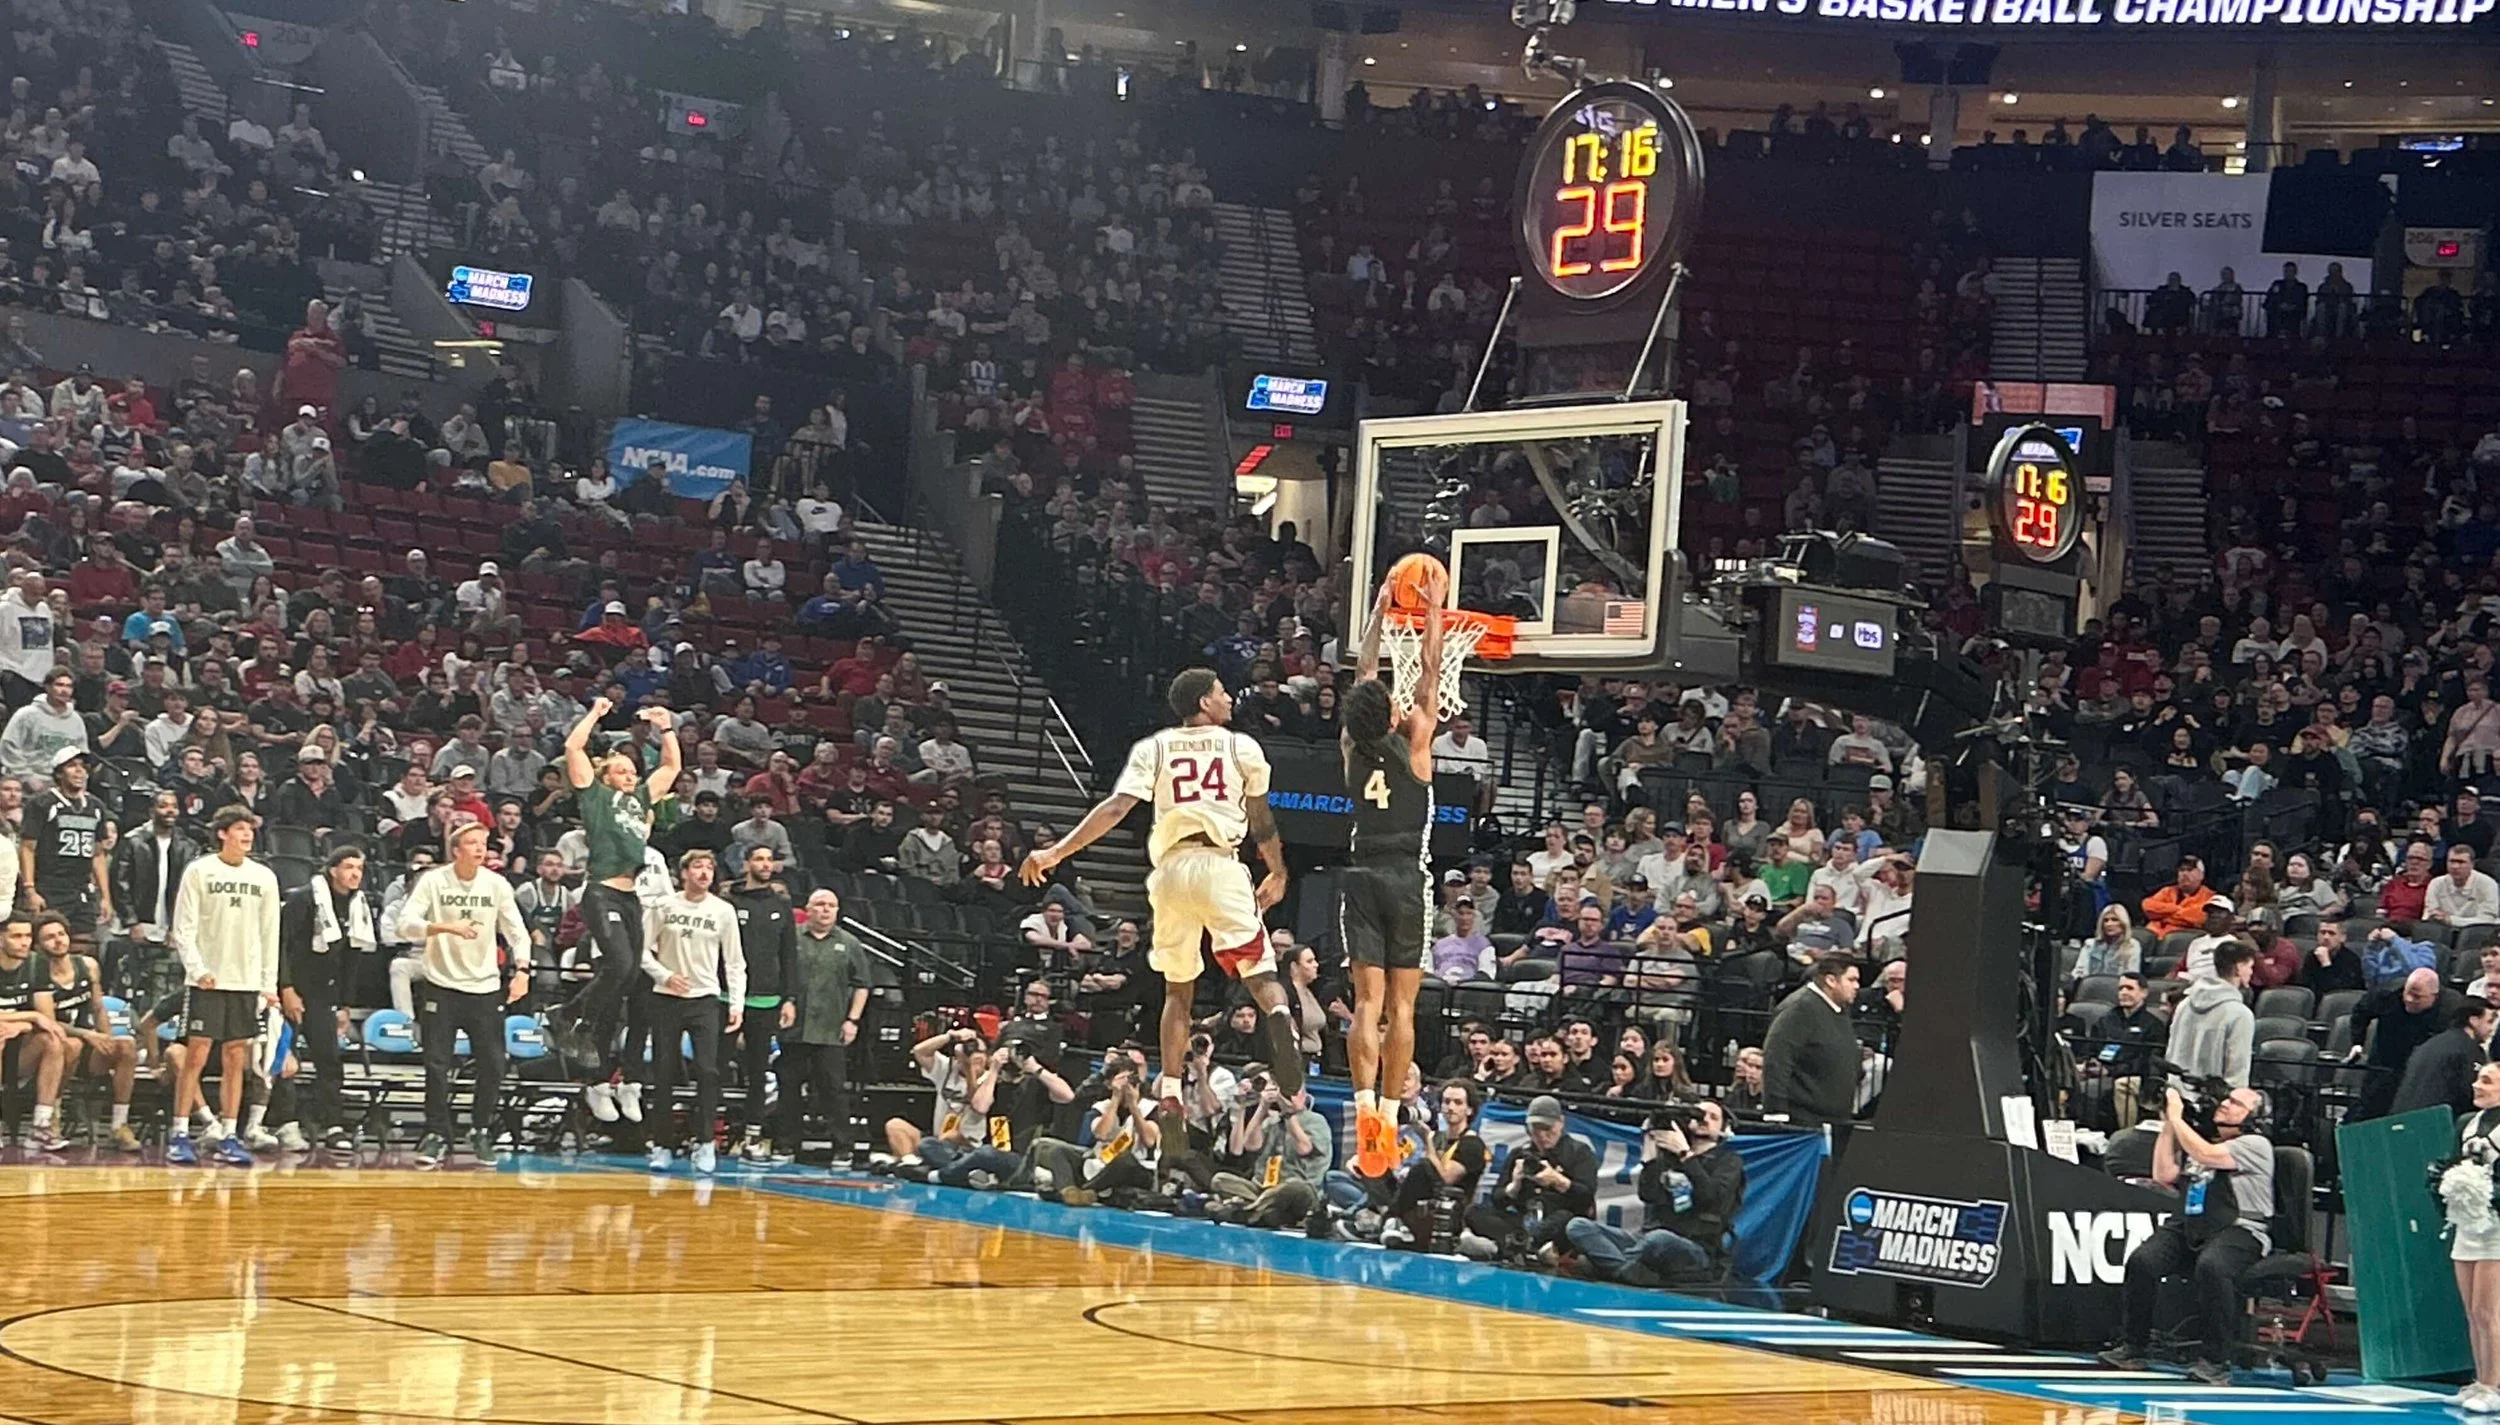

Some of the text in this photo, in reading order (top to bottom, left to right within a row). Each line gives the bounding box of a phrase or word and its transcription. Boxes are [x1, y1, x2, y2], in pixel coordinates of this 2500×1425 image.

[1818, 0, 2102, 23] BASKETBALL
[2112, 0, 2496, 23] CHAMPIONSHIP
[1563, 127, 1658, 184] 17:16
[1552, 181, 1647, 277] 29
[2119, 211, 2253, 229] SILVER SEATS
[467, 272, 509, 289] MARCH
[470, 285, 528, 304] MADNESS
[1267, 379, 1306, 394] MARCH
[1270, 391, 1324, 408] MADNESS
[2014, 498, 2057, 547] 29
[1169, 756, 1229, 804] 24
[1363, 769, 1391, 809] 4
[207, 881, 238, 895] LOCK
[239, 882, 249, 895] IT
[440, 894, 468, 907] LOCK
[470, 896, 479, 907] IT
[663, 913, 691, 926] LOCK
[692, 917, 703, 928] IT
[1871, 1198, 1959, 1238] MARCH
[1878, 1231, 1997, 1275] MADNESS
[2048, 1211, 2173, 1285] NCA
